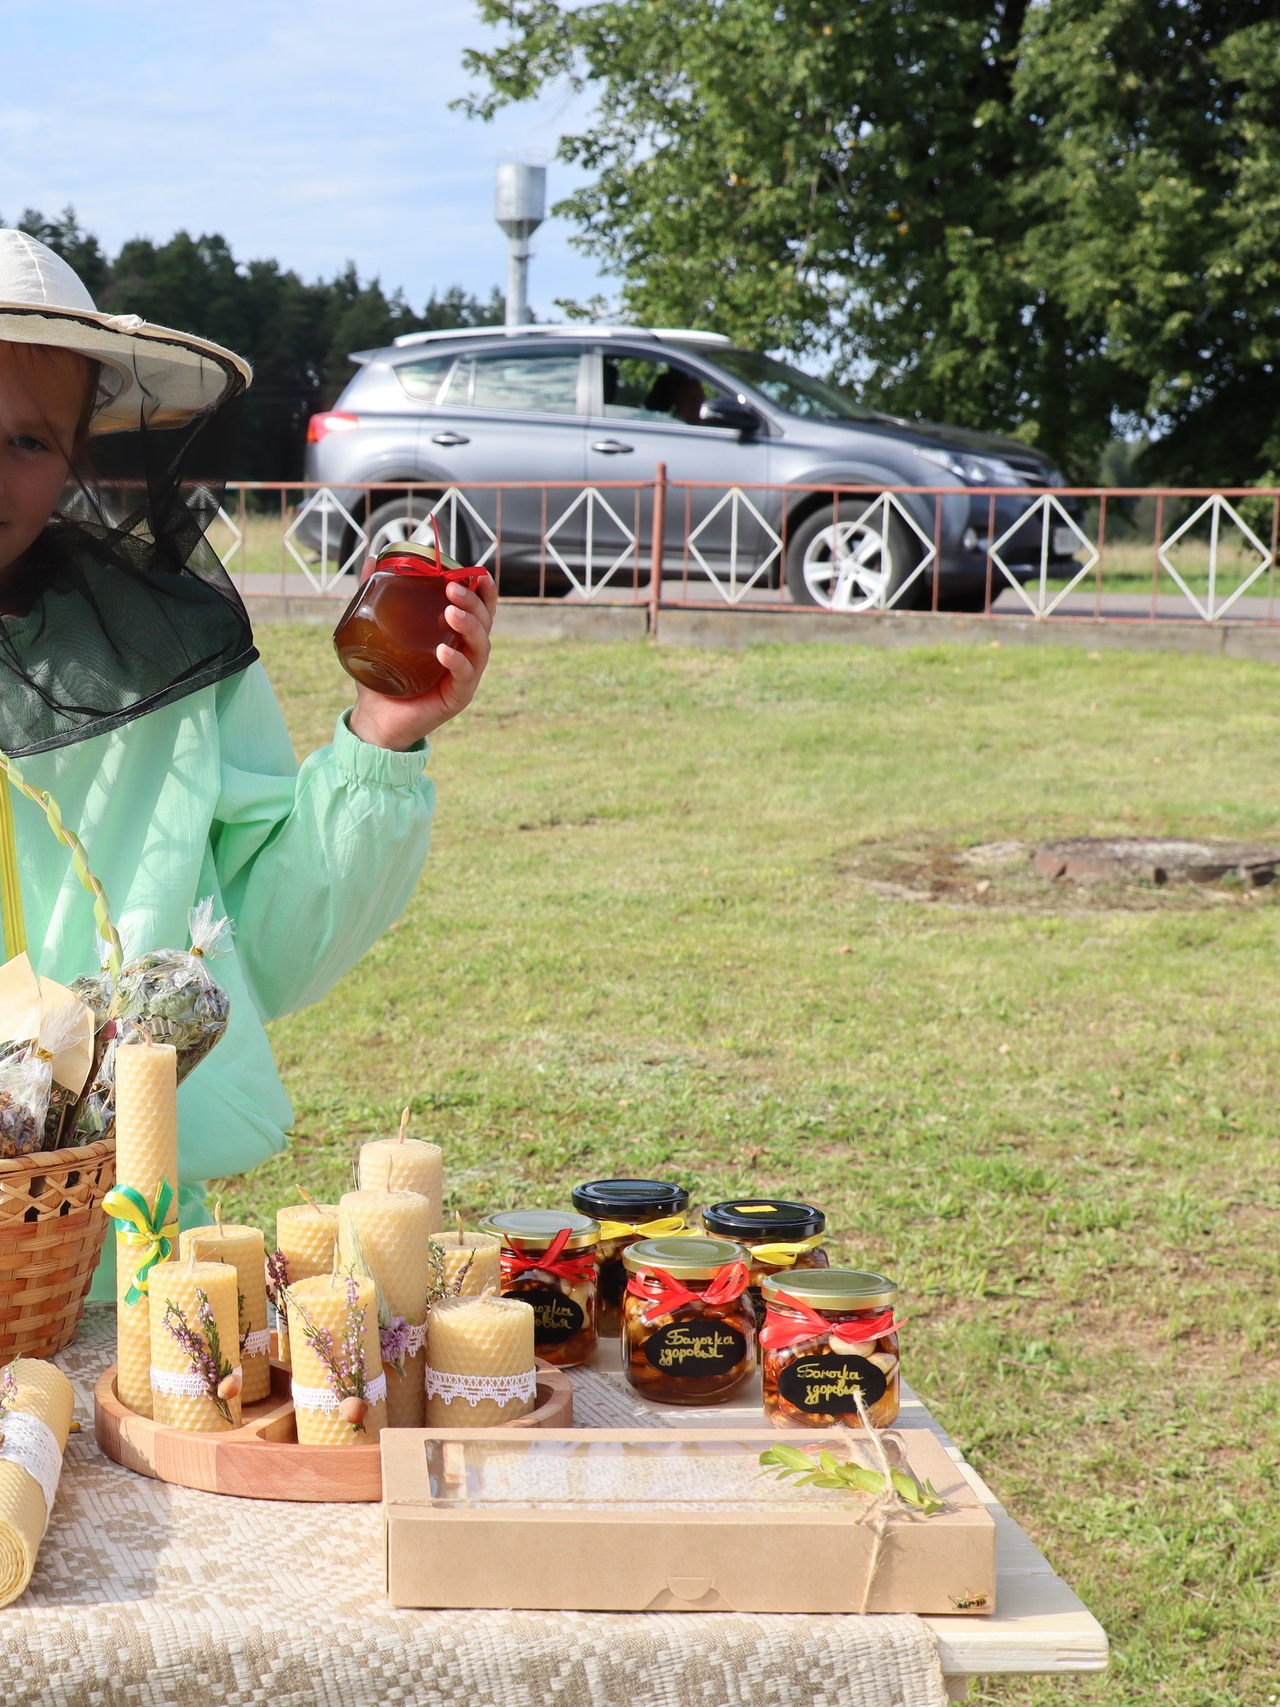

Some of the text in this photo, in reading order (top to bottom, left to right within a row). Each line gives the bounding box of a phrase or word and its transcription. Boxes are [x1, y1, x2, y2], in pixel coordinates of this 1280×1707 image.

[664, 1328, 735, 1346] Баночка
[658, 1343, 724, 1366] здоровья
[796, 1363, 864, 1381] Баночка
